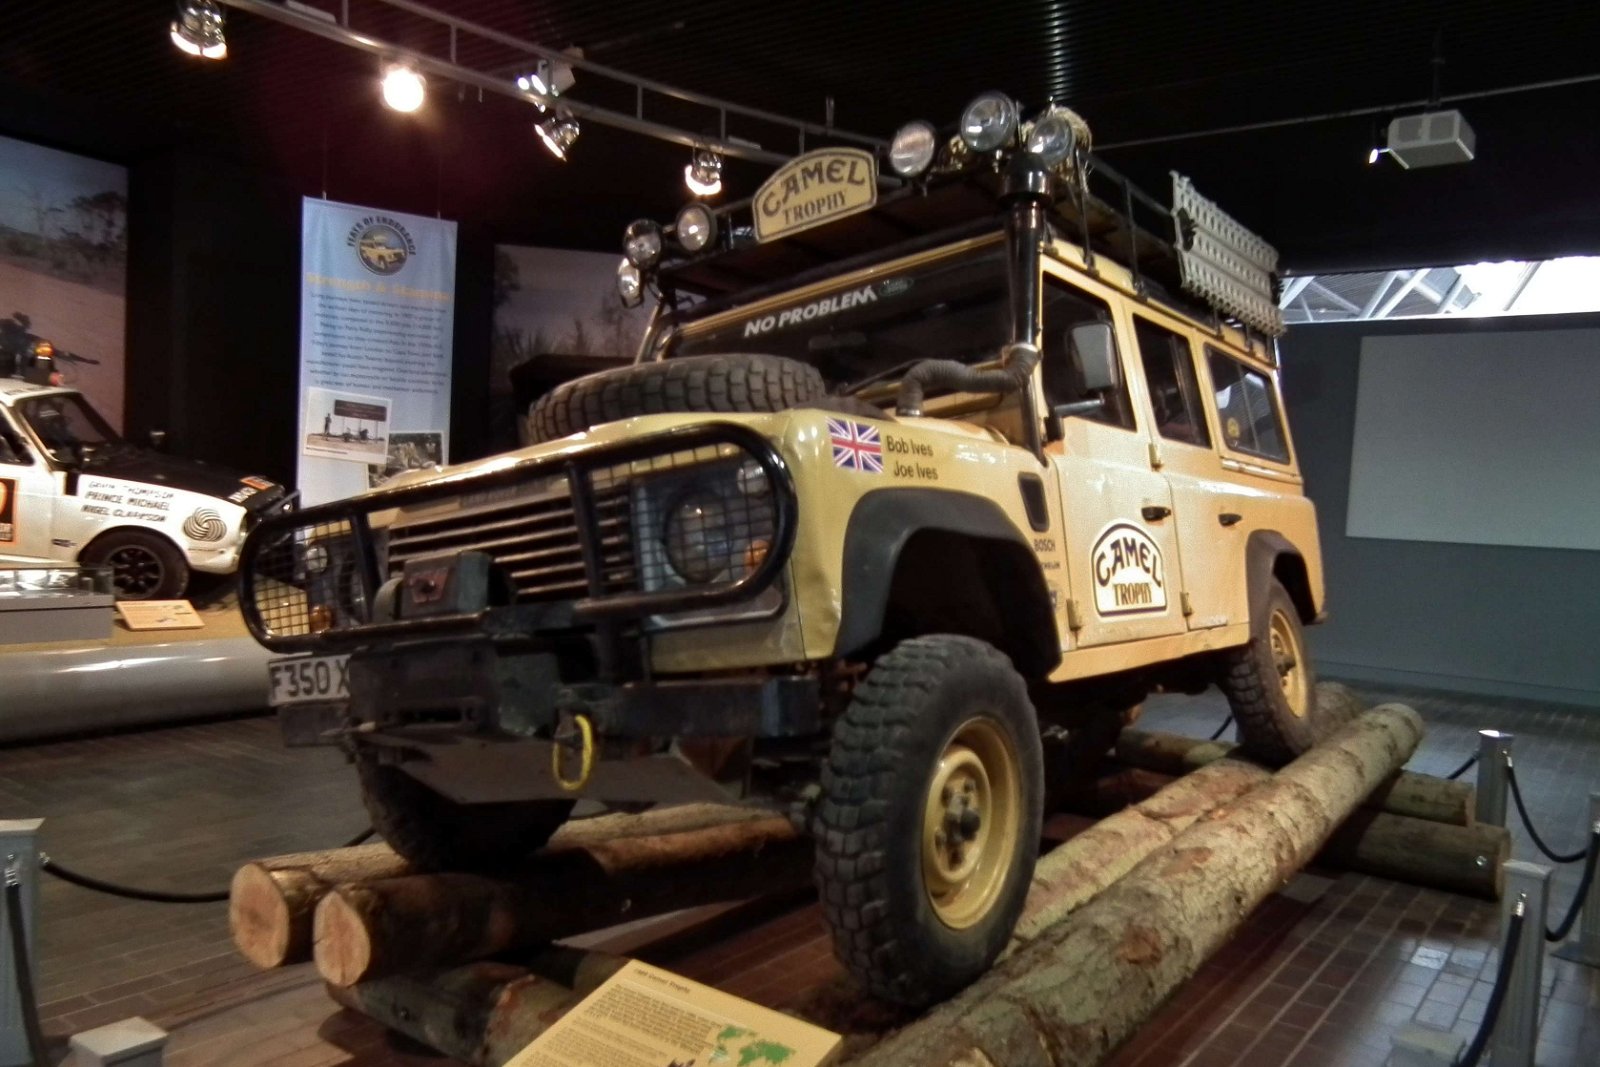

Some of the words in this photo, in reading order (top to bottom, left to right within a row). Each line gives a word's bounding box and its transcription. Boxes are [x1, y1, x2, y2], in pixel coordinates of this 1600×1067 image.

[762, 159, 865, 217] CAMEL
[783, 190, 846, 225] TROPHY
[744, 316, 775, 337] NO
[778, 285, 878, 327] PROBLEM
[886, 435, 909, 453] Bob
[912, 440, 934, 456] Ives
[893, 461, 914, 478] Joe
[916, 463, 938, 480] Ives
[1034, 539, 1056, 552] BOSCH
[1096, 537, 1161, 587] CAMEL
[1113, 582, 1152, 606] TROPHY
[270, 661, 330, 700] F350
